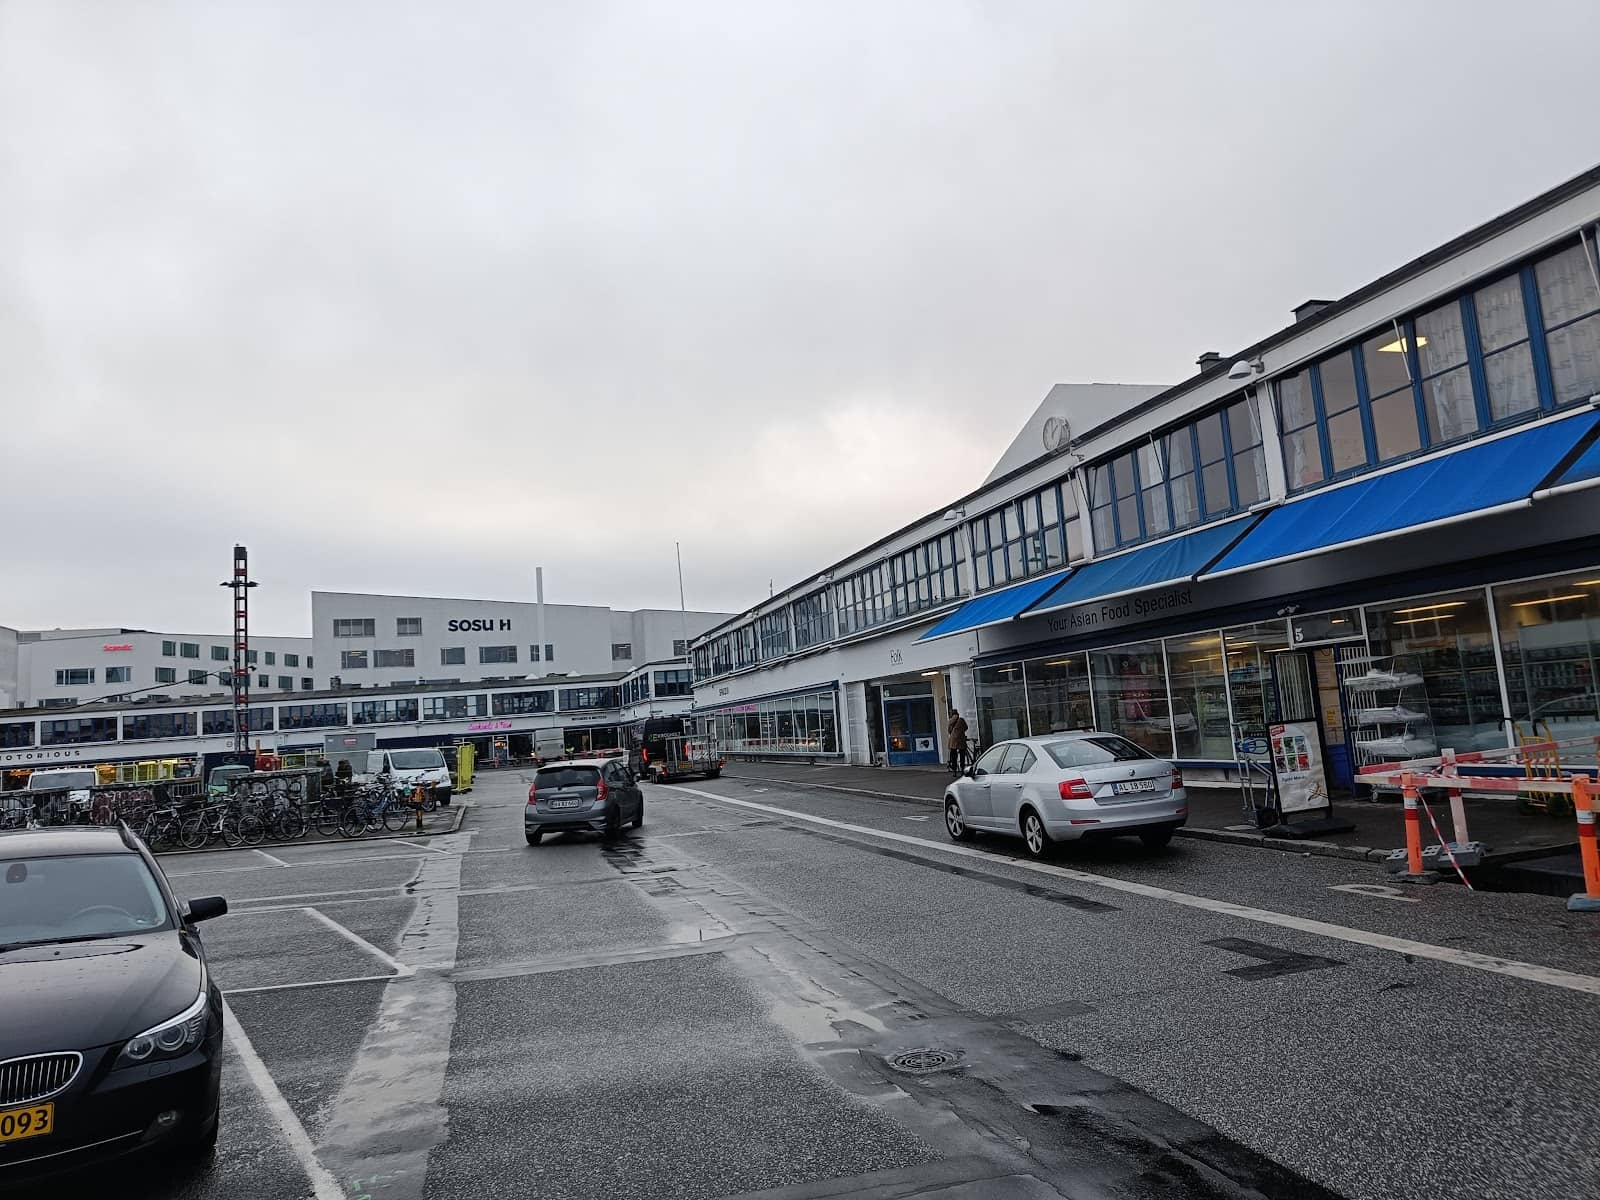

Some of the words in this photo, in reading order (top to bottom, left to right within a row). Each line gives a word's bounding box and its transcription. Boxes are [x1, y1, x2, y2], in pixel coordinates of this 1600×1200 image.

[1047, 616, 1069, 633] Your
[1070, 611, 1098, 628] Asian
[1101, 602, 1130, 621] Food
[1135, 590, 1193, 616] Specialist
[448, 619, 494, 632] SOSU
[500, 619, 511, 631] H
[1295, 628, 1304, 642] 5
[0, 750, 81, 761] OTORIOUS
[1119, 783, 1129, 791] AL
[1, 1109, 48, 1136] 093
